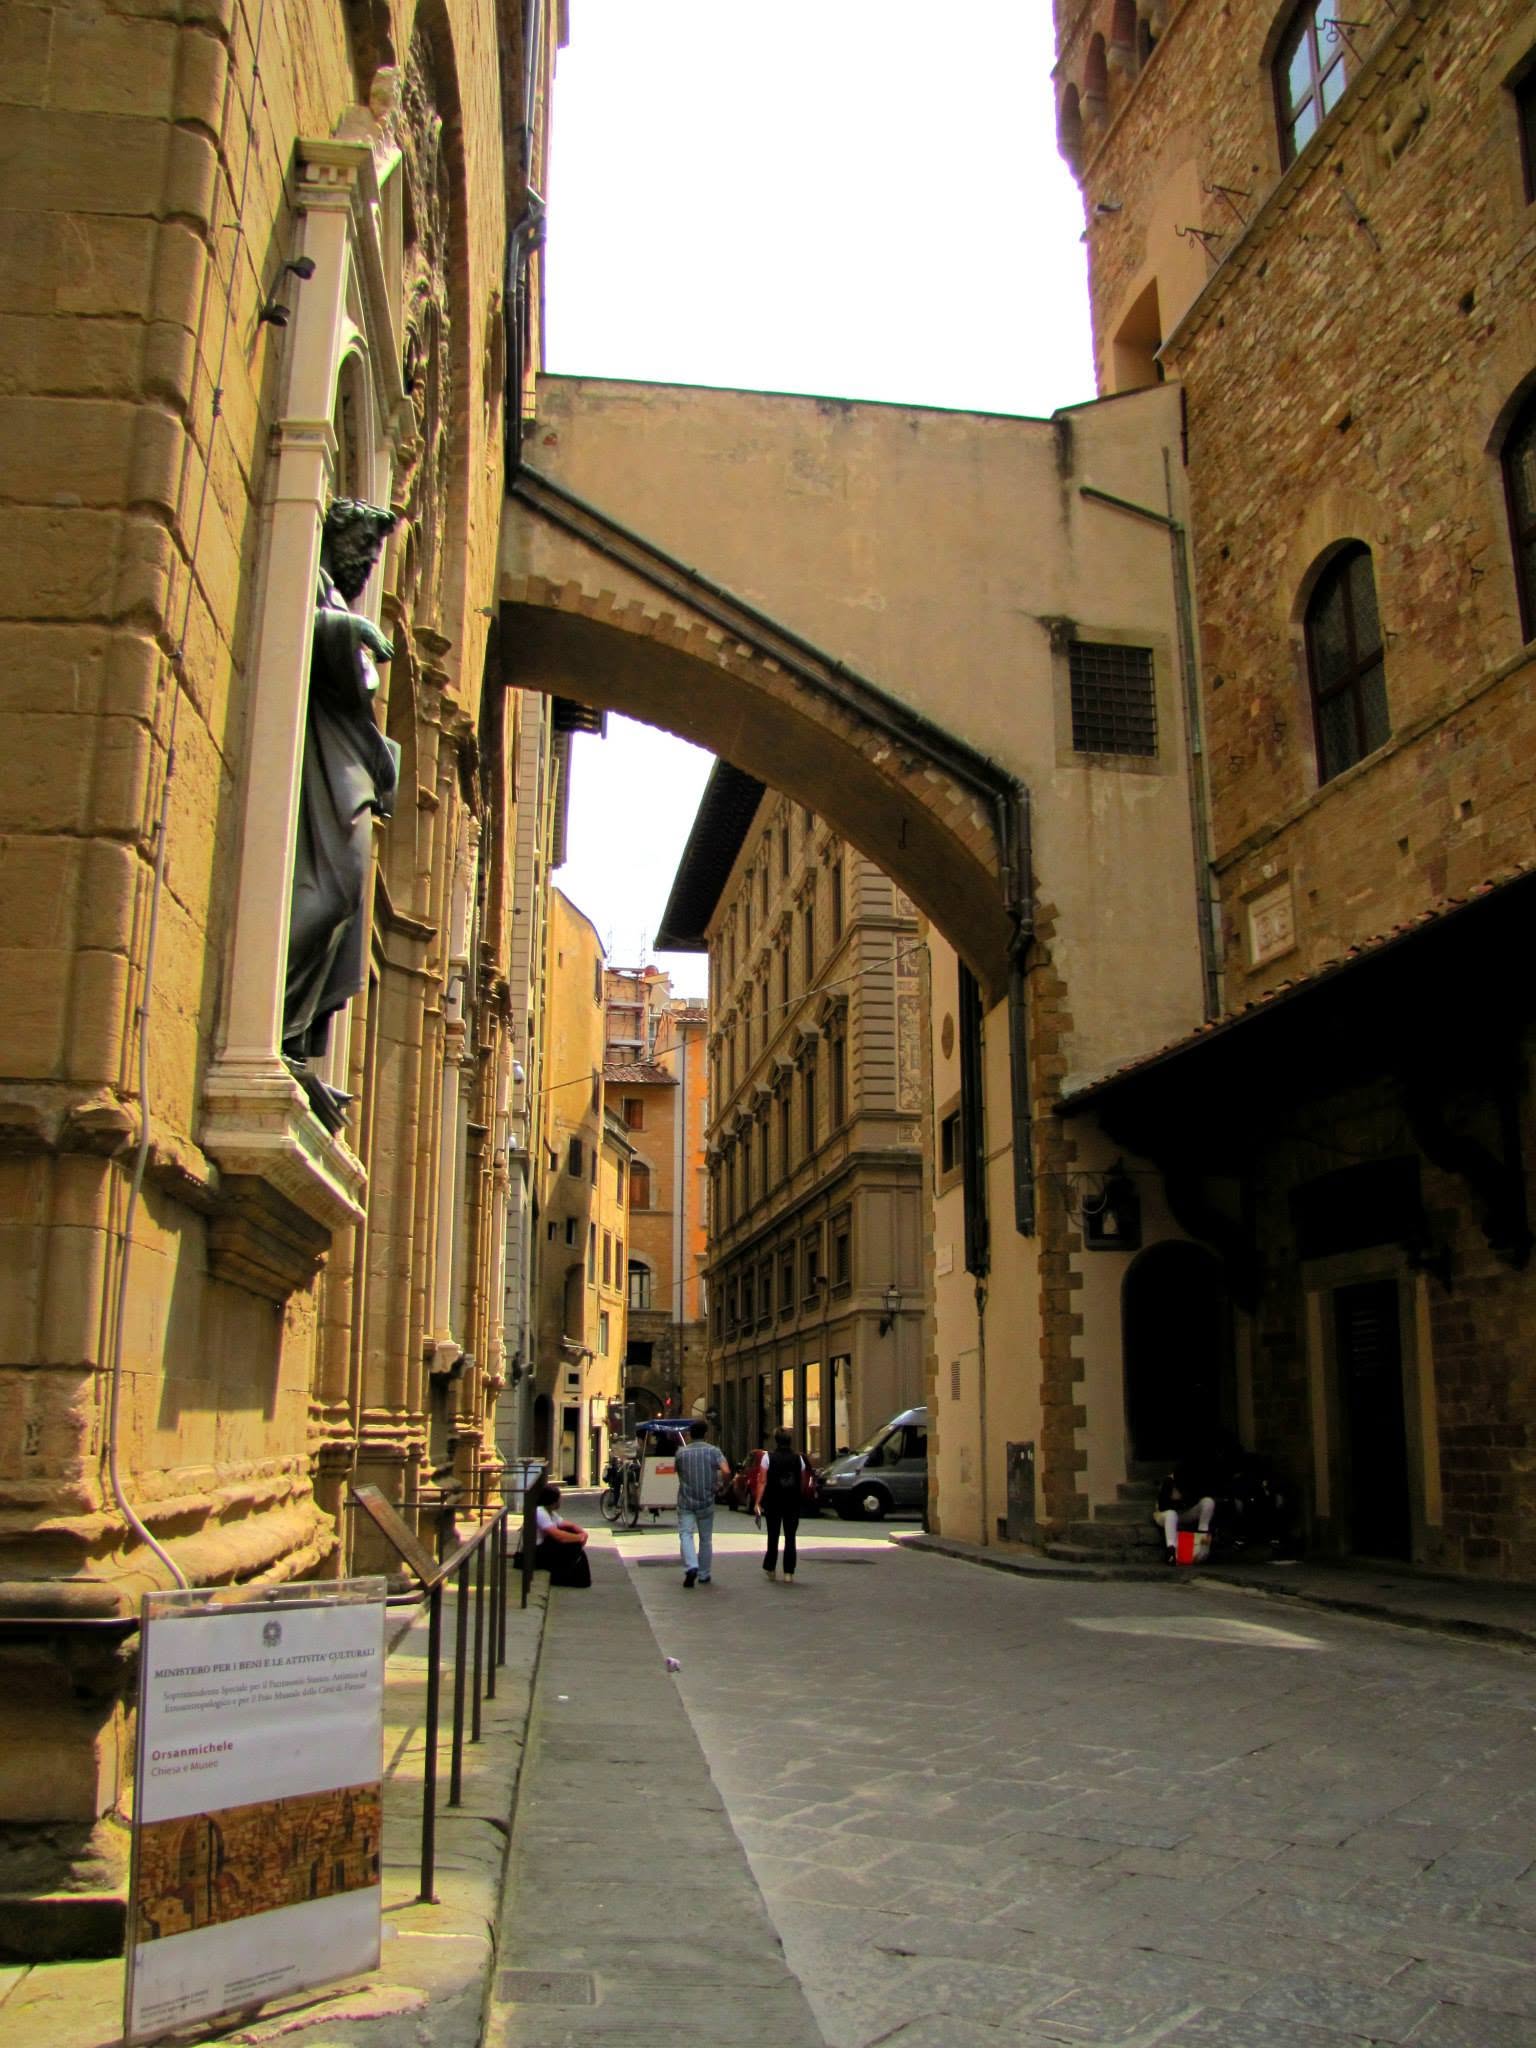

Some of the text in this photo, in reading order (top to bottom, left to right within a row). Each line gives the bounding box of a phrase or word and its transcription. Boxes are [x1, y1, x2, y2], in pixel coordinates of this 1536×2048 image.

[154, 1665, 211, 1679] MINISTERO
[213, 1663, 230, 1673] PER
[239, 1659, 262, 1670] BENI
[264, 1658, 270, 1668] E
[272, 1656, 284, 1667] LE
[329, 1648, 375, 1661] CULTURALI
[152, 1741, 234, 1761] Orsanmichele
[151, 1765, 182, 1777] Chiesa
[190, 1760, 219, 1771] Museo
